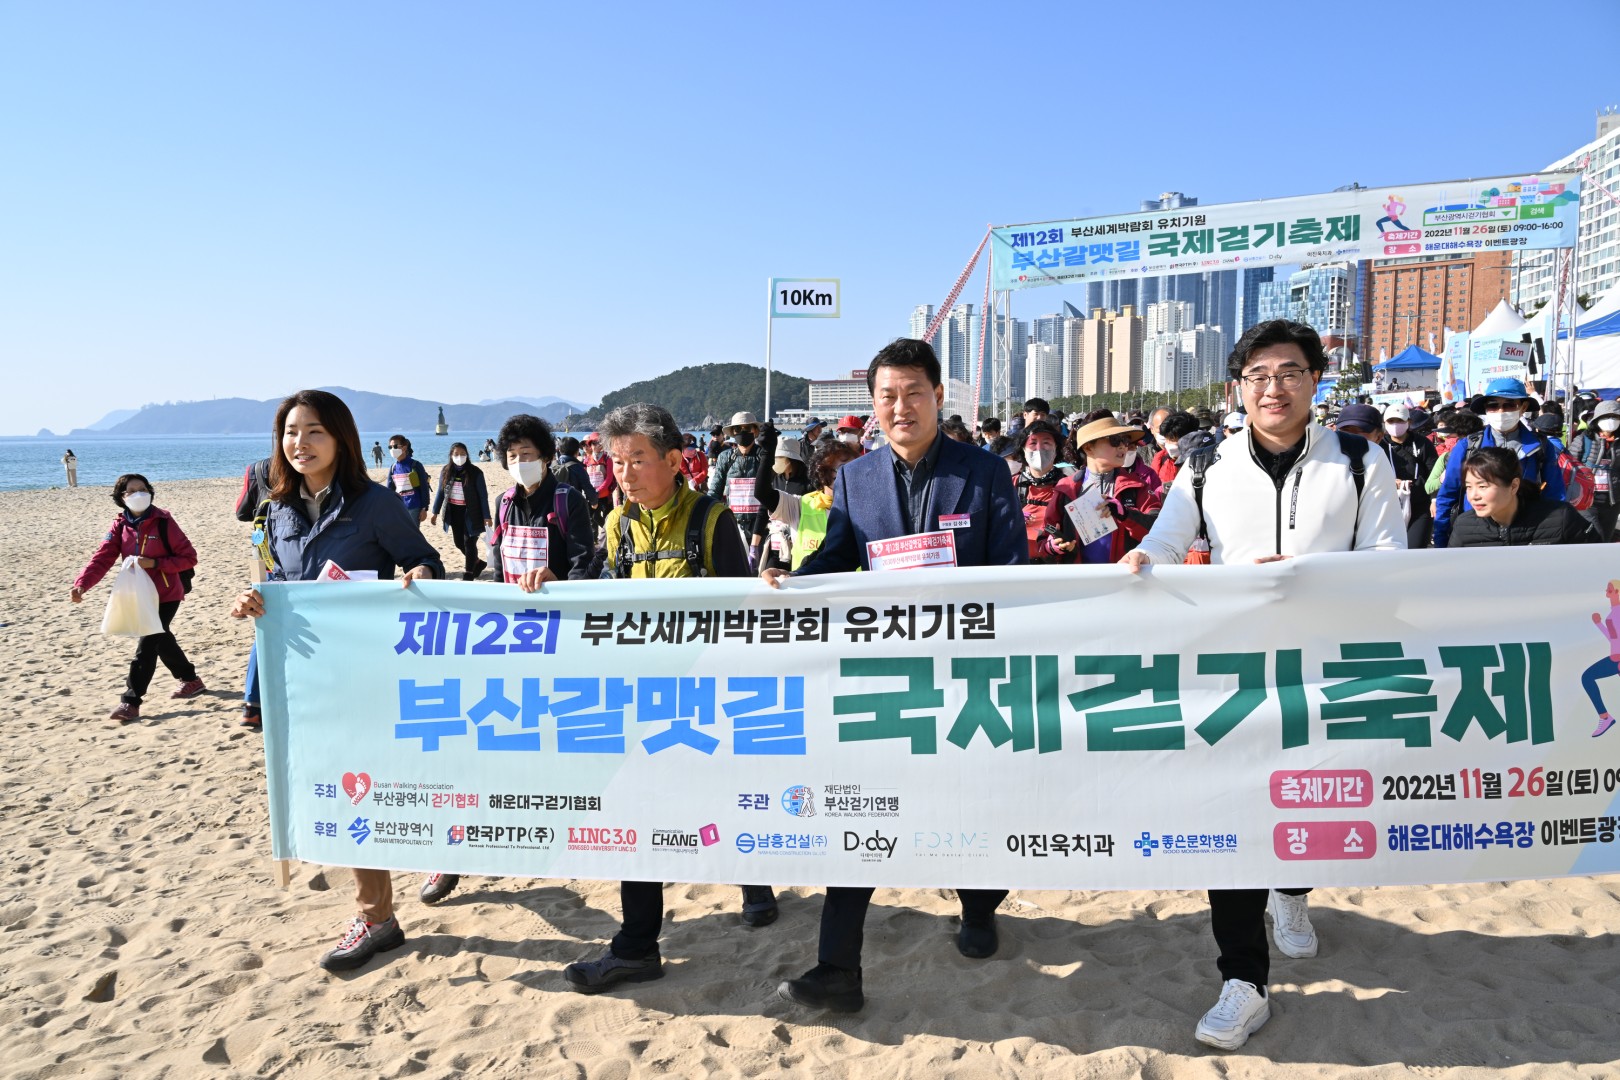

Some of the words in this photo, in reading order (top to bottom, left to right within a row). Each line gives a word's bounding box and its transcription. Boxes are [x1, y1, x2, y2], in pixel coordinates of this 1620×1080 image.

[1435, 210, 1496, 221] 부산광역시걷기협회
[1530, 207, 1544, 216] 검색
[1011, 228, 1063, 247] 제12회
[1071, 220, 1153, 237] 부산세계박람회
[1158, 215, 1206, 230] 유치기원
[1388, 231, 1418, 240] 축제기간
[1425, 228, 1452, 237] 2022년
[1454, 226, 1470, 235] 11월
[1473, 225, 1495, 234] 26일
[1497, 224, 1511, 233] (토)
[1514, 222, 1563, 232] 09:00-16:00
[1011, 240, 1140, 271] 부산갈맷길
[1148, 215, 1360, 257] 국제걷기축제
[1426, 240, 1482, 250] 해운대해수욕장
[1485, 237, 1527, 247] 이벤트광장
[780, 289, 833, 306] 10Km
[1504, 346, 1525, 357] 5Km
[394, 609, 561, 655] 제12회
[581, 607, 830, 646] 부산세계박람회
[844, 602, 996, 642] 유치기원
[395, 676, 806, 755] 부산갈맷길
[833, 641, 1555, 755] 국제걷기축제
[393, 782, 417, 790] Walking
[824, 785, 860, 794] 재단법인
[1281, 777, 1363, 802] 축제기간
[1382, 774, 1456, 800] 2022년
[1460, 769, 1502, 799] 11월
[1508, 767, 1563, 797] 26일
[1567, 768, 1598, 796] (토)
[315, 784, 336, 798] 주최
[373, 792, 428, 807] 부산광역시
[432, 793, 479, 808] 걷기협회
[489, 794, 601, 811] 해운대구걷기협회
[738, 794, 769, 810] 주관
[825, 797, 898, 811] 부산걷기연맹
[315, 821, 337, 837] 후원
[374, 821, 433, 839] 부산광역시
[467, 826, 554, 845] 한국PTP(주)
[568, 828, 611, 844] LINC
[613, 829, 637, 845] 3.0
[1388, 821, 1535, 851] 해운대해수욕장
[652, 834, 698, 847] CHANG
[758, 834, 827, 848] 남흥건설(주)
[914, 832, 953, 849] FOR
[961, 832, 989, 849] ME
[1007, 834, 1114, 857] 이진욱치과
[1162, 834, 1237, 850] 좋은문화병원
